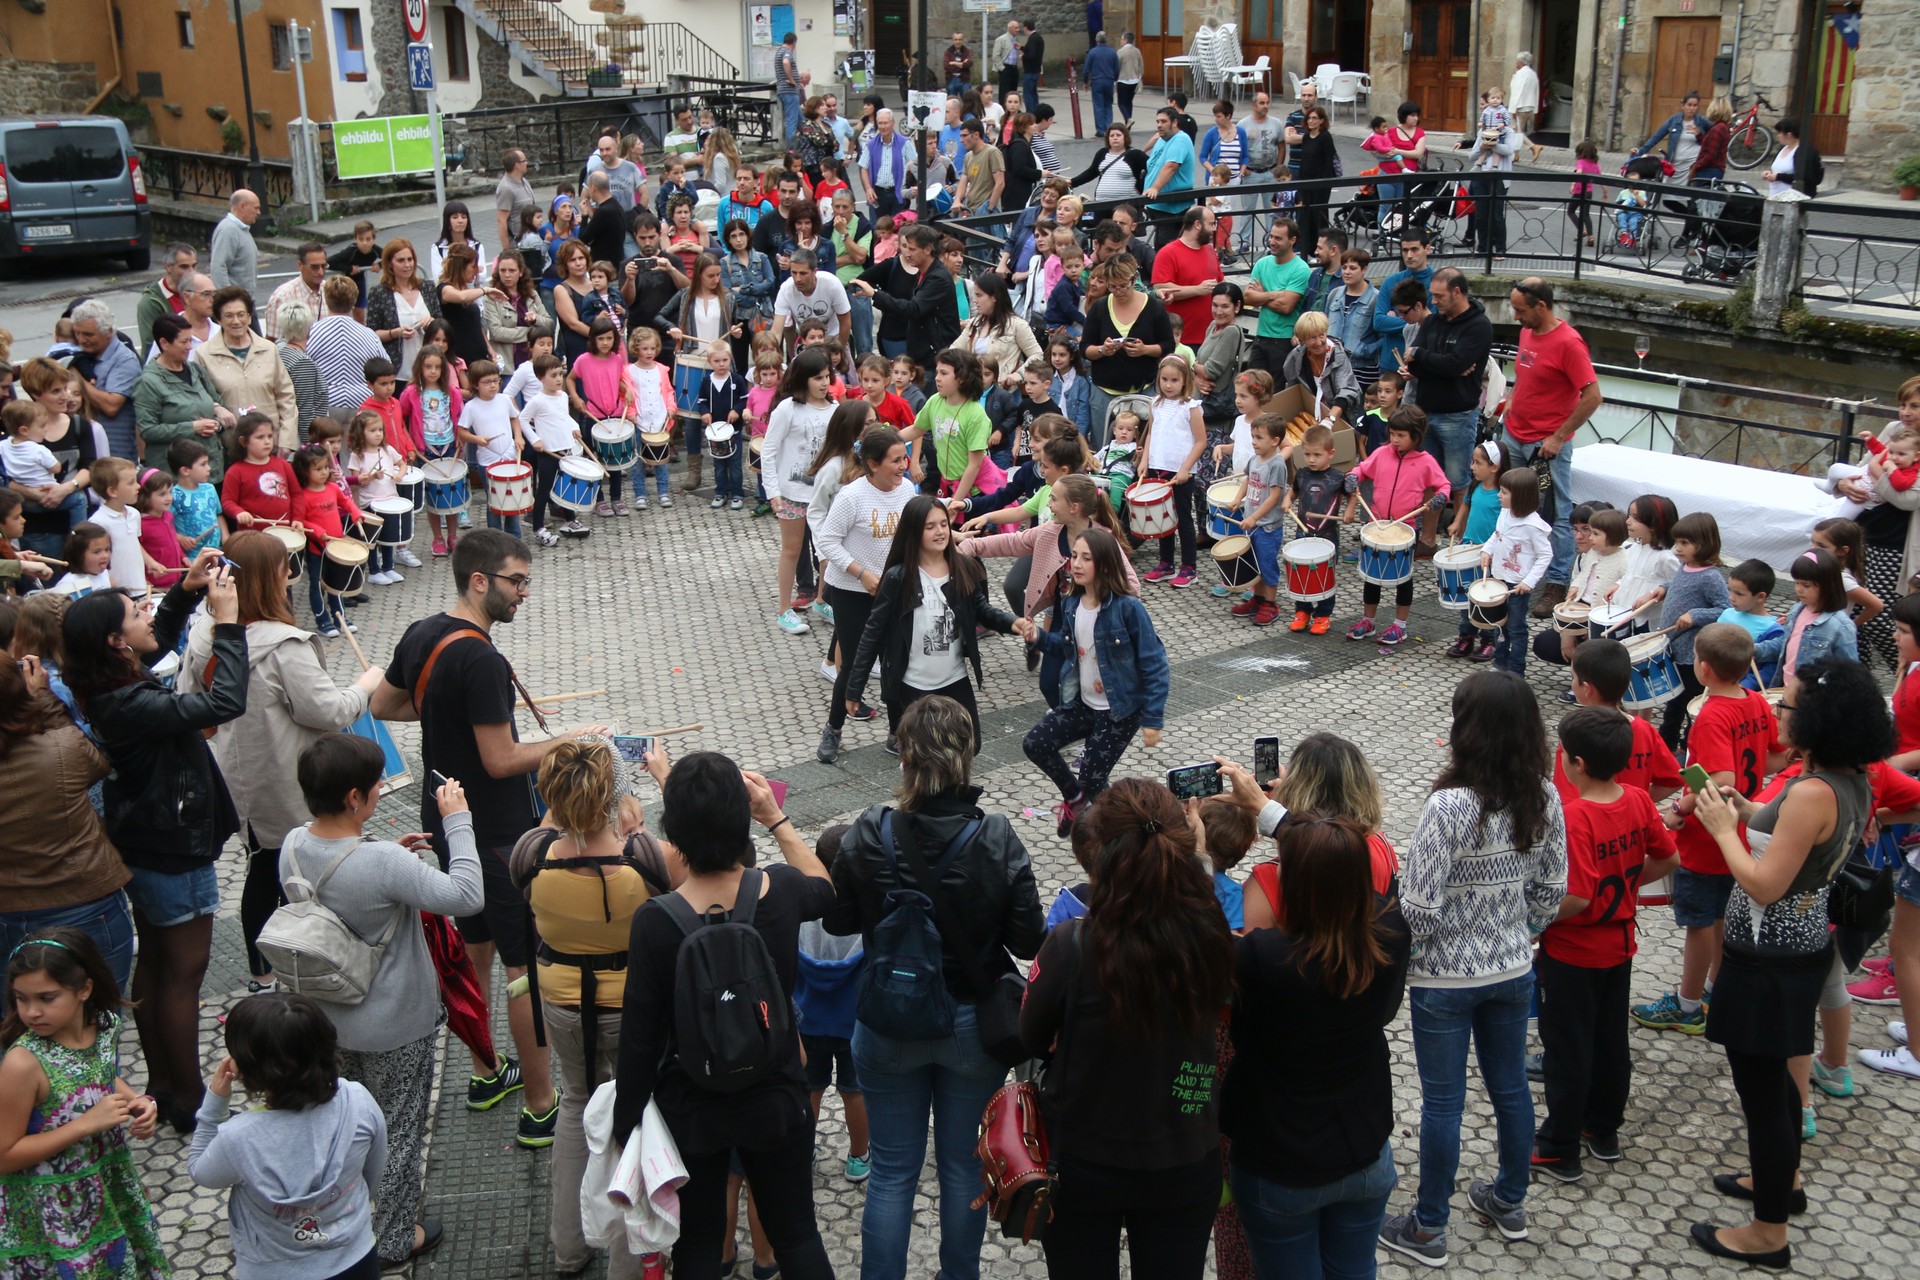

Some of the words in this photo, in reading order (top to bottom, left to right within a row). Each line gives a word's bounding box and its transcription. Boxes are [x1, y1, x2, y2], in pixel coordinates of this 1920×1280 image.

[408, 0, 421, 18] 20
[341, 129, 385, 146] ehbildu
[396, 125, 433, 141] ehbild
[870, 508, 900, 539] hell
[1741, 748, 1758, 799] 3
[1596, 864, 1645, 924] 27
[1173, 1074, 1197, 1087] AND
[1172, 1085, 1193, 1100] THE
